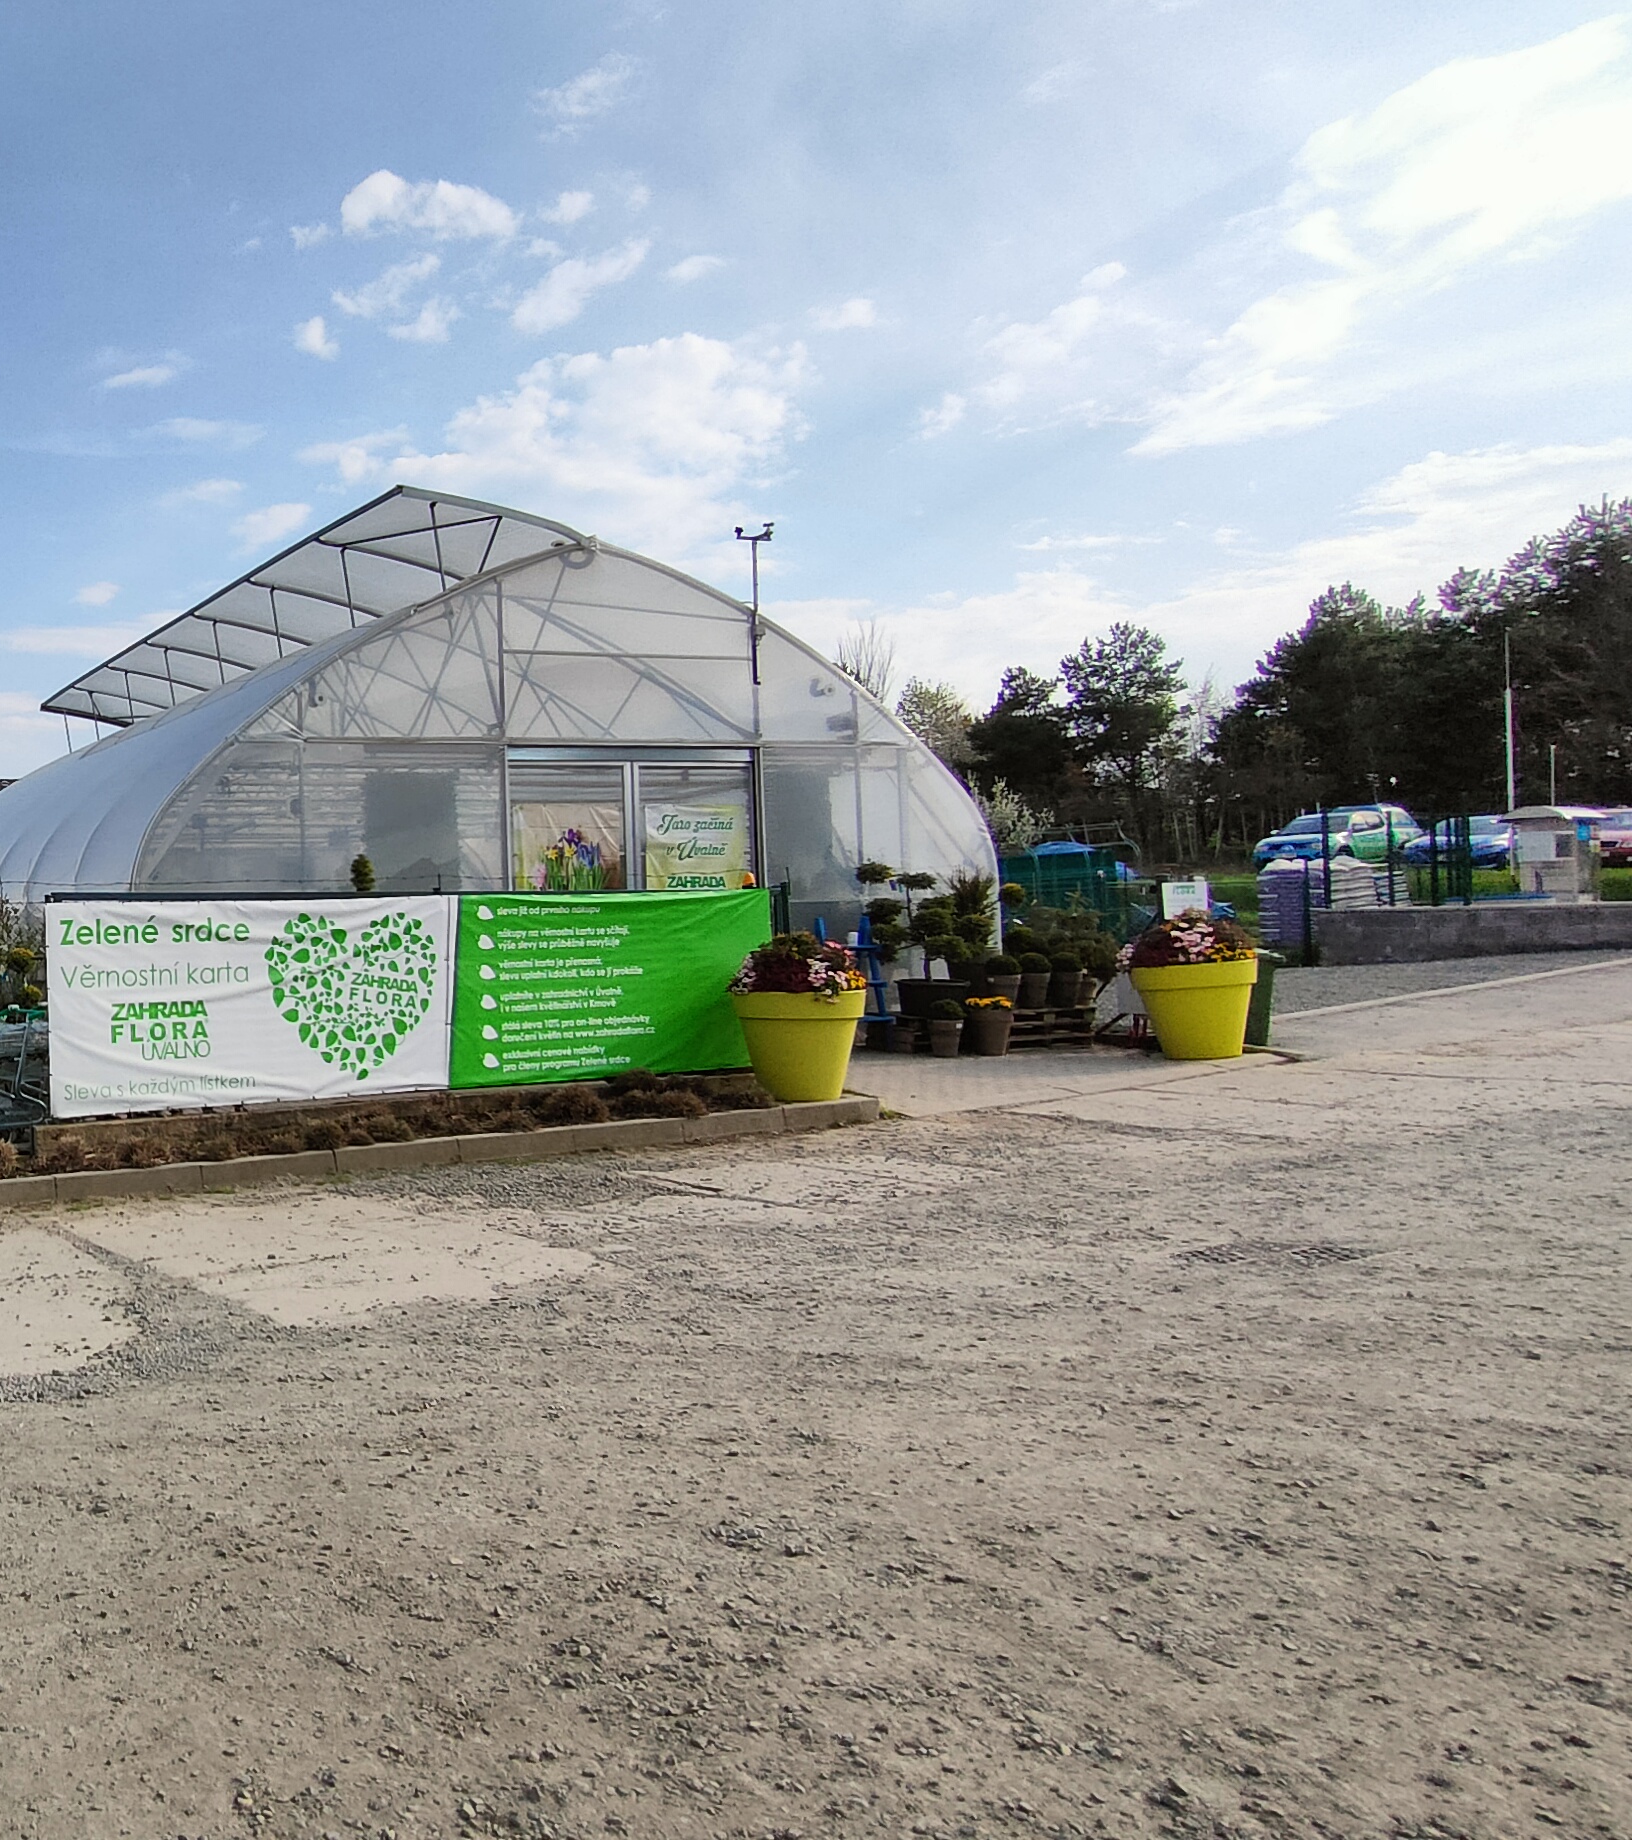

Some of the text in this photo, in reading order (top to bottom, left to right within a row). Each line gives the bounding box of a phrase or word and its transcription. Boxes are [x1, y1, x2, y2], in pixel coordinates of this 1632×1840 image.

[656, 814, 734, 836] Jaro začíná
[666, 836, 728, 861] v Úvalně
[667, 875, 726, 888] ZAHRADA
[528, 906, 540, 914] od
[59, 914, 250, 945] Zelené srdce
[556, 958, 564, 968] je
[60, 961, 249, 989] Věrnostní karta
[351, 972, 419, 994] ZAHRADA
[349, 987, 417, 1010] FLORA
[111, 1000, 208, 1021] ZAHRADA
[111, 1020, 209, 1044] FLORA
[561, 1020, 574, 1028] pro
[141, 1039, 212, 1061] ÚVALNO
[503, 1064, 516, 1073] pro
[64, 1074, 257, 1100] Sleva s každým lístkem
